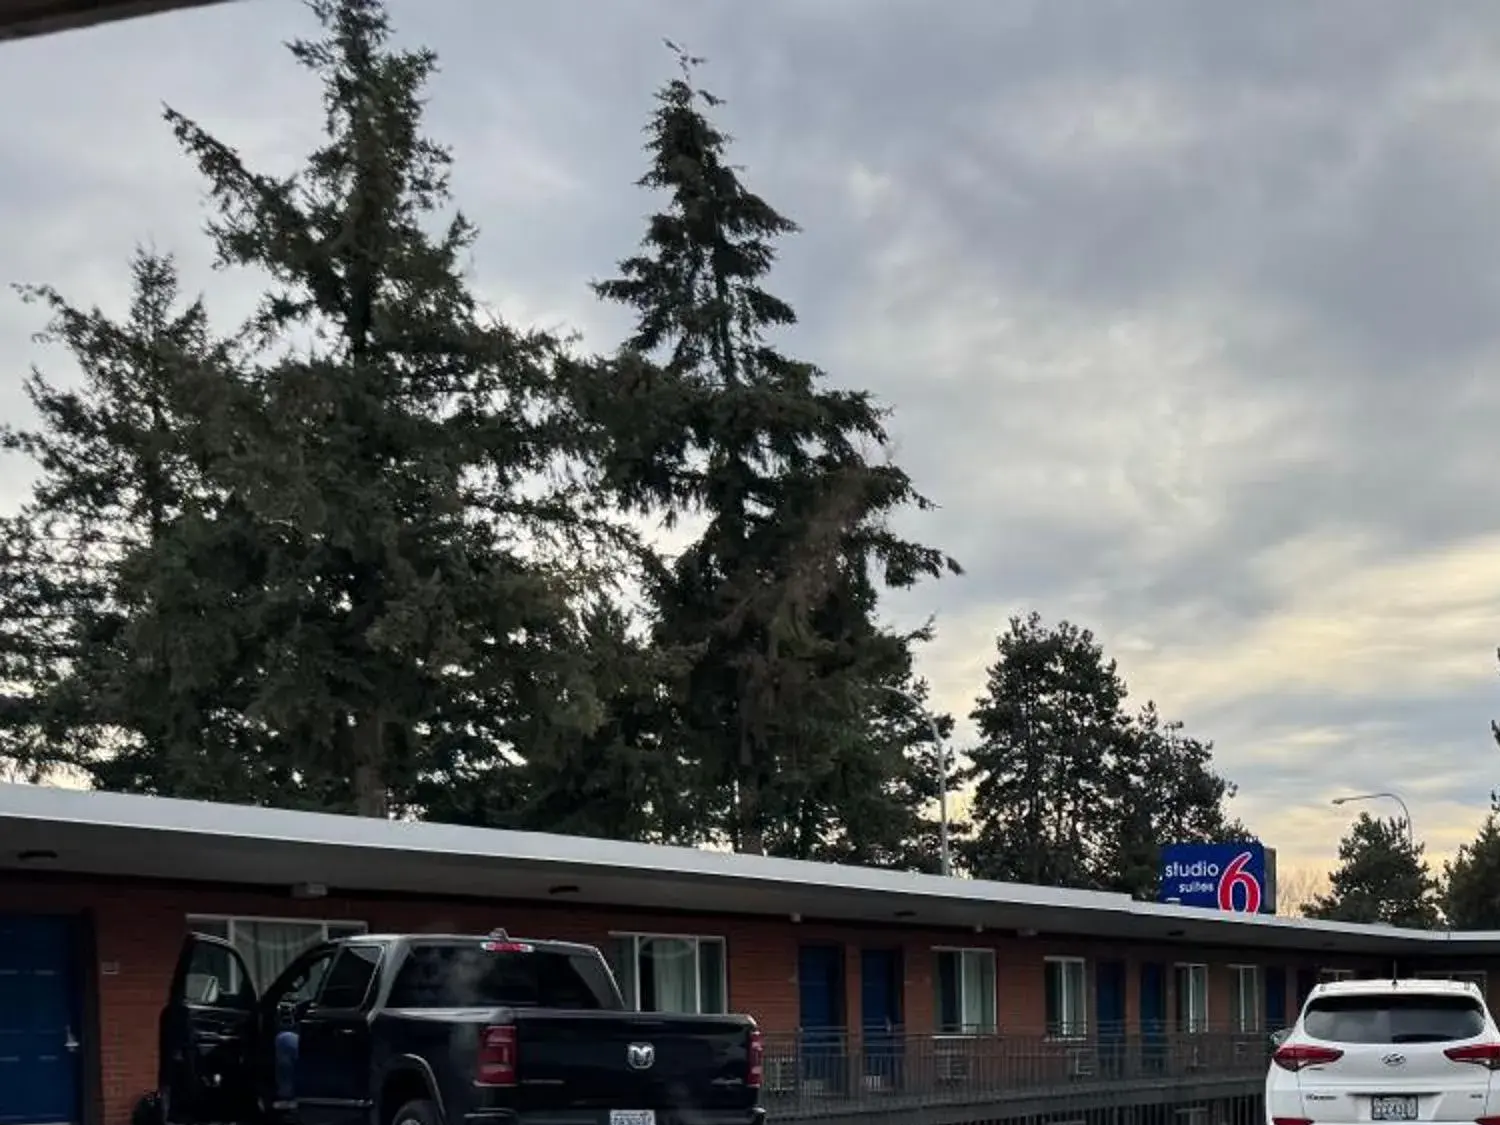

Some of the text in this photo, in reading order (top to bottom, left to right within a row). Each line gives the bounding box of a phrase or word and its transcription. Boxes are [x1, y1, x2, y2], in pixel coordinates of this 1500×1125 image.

[1165, 861, 1219, 877] studio
[1179, 882, 1214, 893] suites
[1218, 851, 1260, 913] 6
